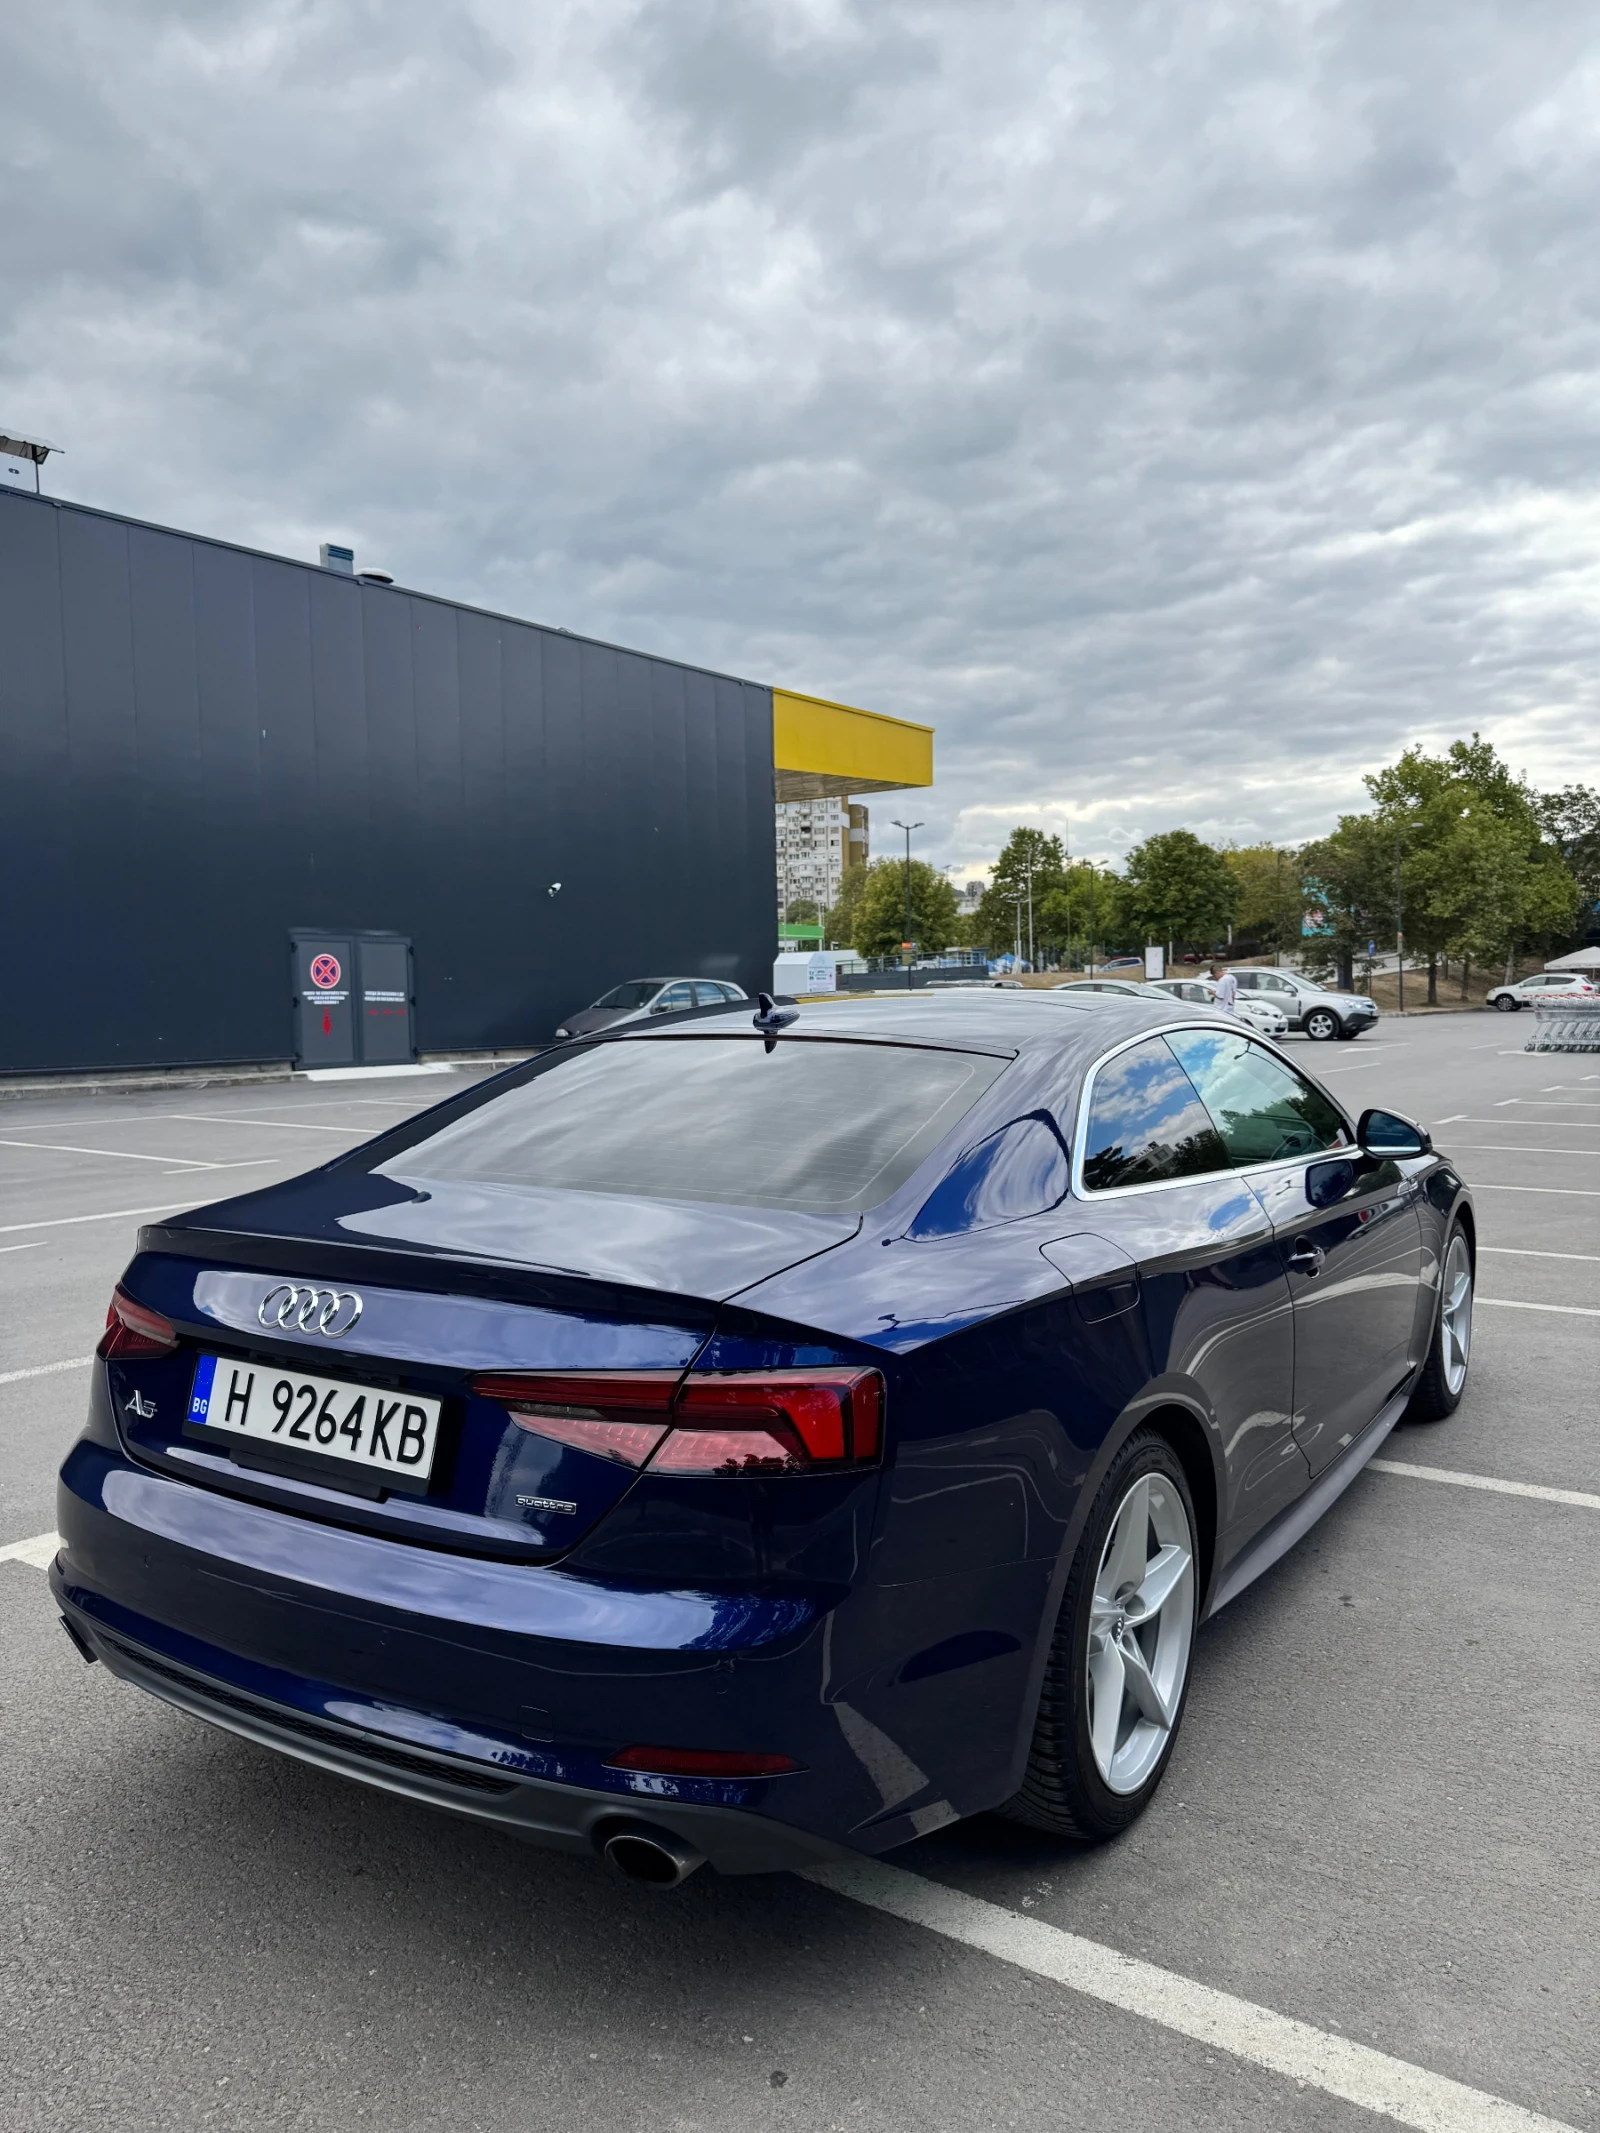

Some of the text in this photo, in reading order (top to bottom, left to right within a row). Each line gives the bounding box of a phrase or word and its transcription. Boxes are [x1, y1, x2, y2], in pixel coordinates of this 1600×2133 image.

[125, 1390, 158, 1418] A5
[192, 1397, 208, 1415] BG
[225, 1369, 255, 1426] H
[516, 1497, 573, 1512] quattro
